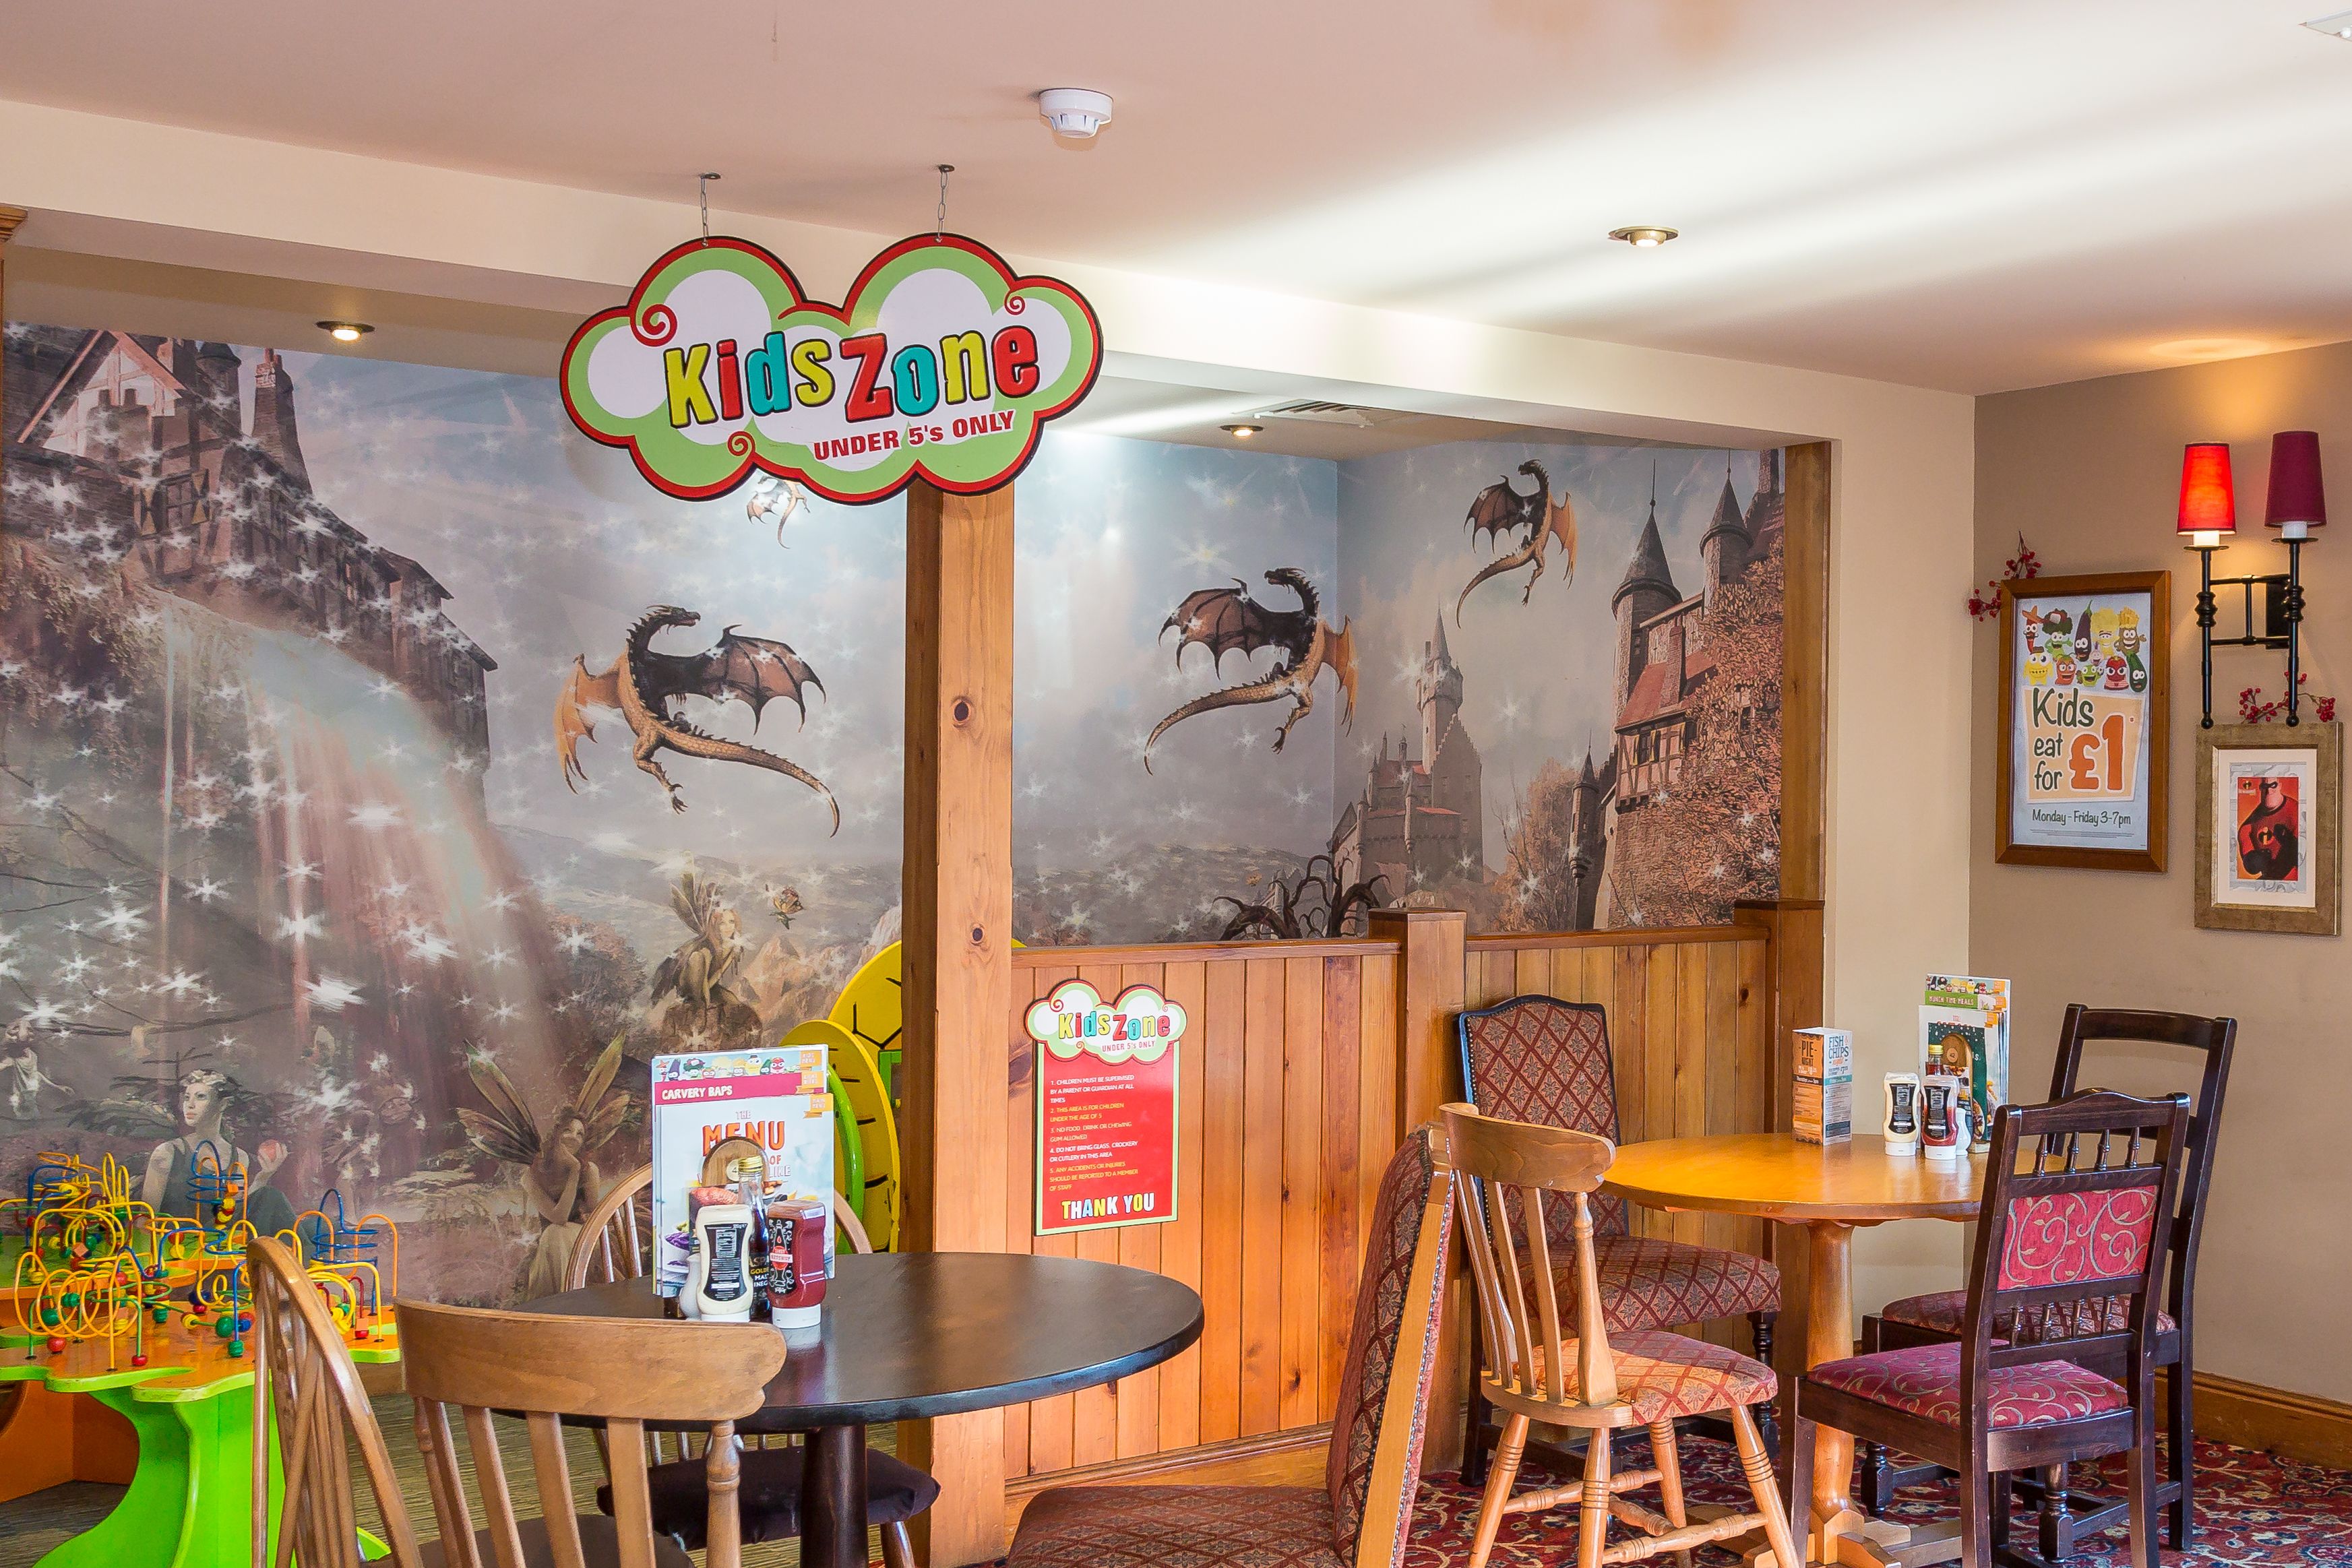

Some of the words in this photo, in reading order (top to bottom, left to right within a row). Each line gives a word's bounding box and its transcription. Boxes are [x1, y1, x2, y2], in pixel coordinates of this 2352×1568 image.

[664, 325, 1041, 429] KidsZone
[813, 430, 900, 462] UNDER
[908, 424, 945, 447] 5's
[952, 409, 1015, 438] ONLY
[2031, 687, 2095, 728] Kids
[2034, 732, 2063, 757] eat
[2069, 714, 2126, 790] £1
[2033, 760, 2063, 792] for
[2031, 809, 2066, 825] Monday
[2074, 810, 2099, 827] Friday
[2100, 811, 2131, 828] 3-7pm
[1958, 997, 1975, 1005] MEALS
[1102, 1043, 1125, 1053] UNDER
[1127, 1042, 1137, 1050] 5's
[1139, 1040, 1155, 1048] ONLY
[1801, 1040, 1814, 1057] PIE
[1828, 1035, 1844, 1048] FISH
[1828, 1046, 1849, 1059] CHIPS
[1105, 1074, 1135, 1082] SUPERVISED
[661, 1086, 706, 1101] CARVERY
[708, 1084, 733, 1097] BAPS
[735, 1110, 751, 1120] THE
[769, 1154, 782, 1165] OF
[1067, 1164, 1096, 1172] ACCIDENTS
[1078, 1172, 1105, 1180] REPORTED
[1061, 1197, 1119, 1221] THANK
[1123, 1192, 1155, 1214] YOU
